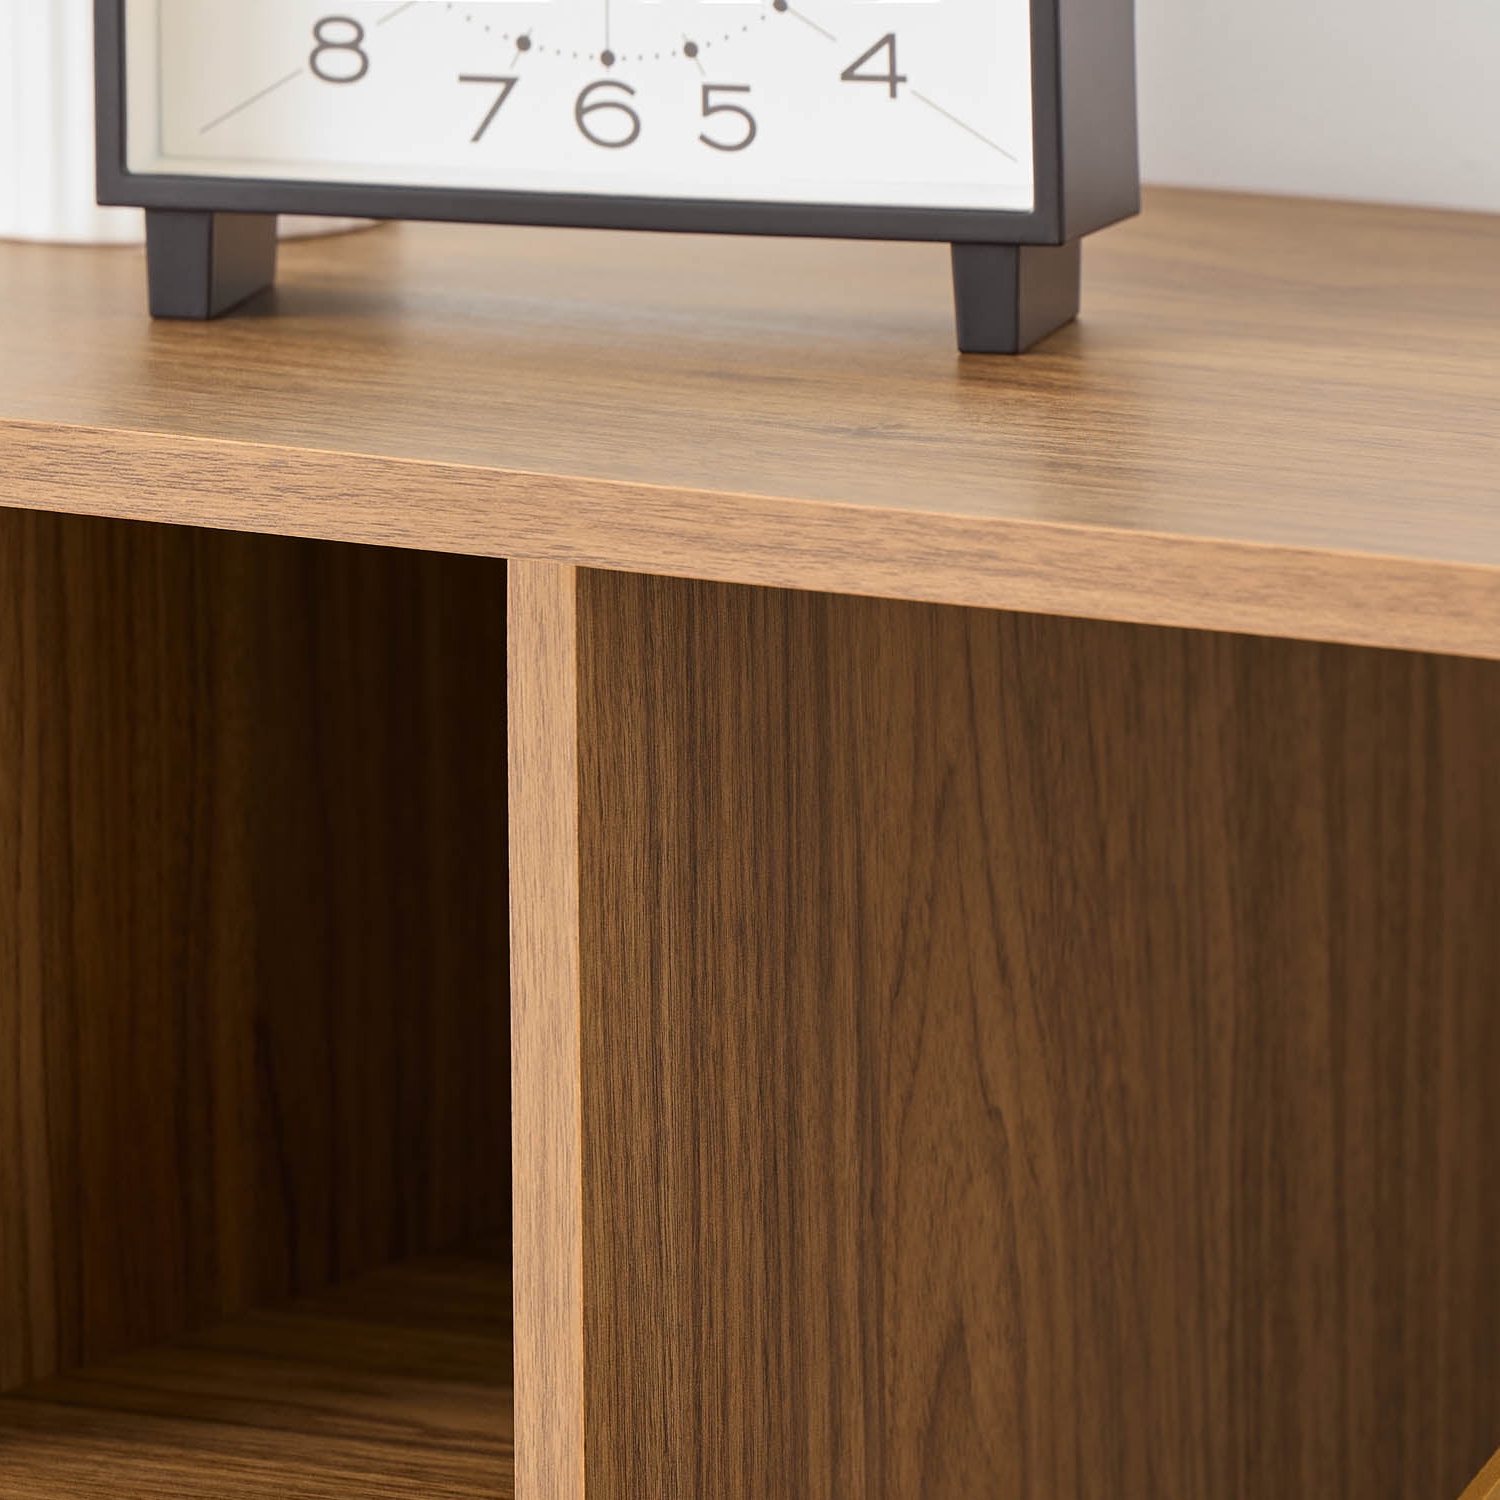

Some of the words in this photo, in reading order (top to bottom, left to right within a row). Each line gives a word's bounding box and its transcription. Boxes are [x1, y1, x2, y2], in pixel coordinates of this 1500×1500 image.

[308, 16, 369, 83] 8
[840, 32, 907, 99] 4
[458, 75, 518, 142] 7
[574, 79, 641, 148] 6
[699, 84, 757, 151] 5
